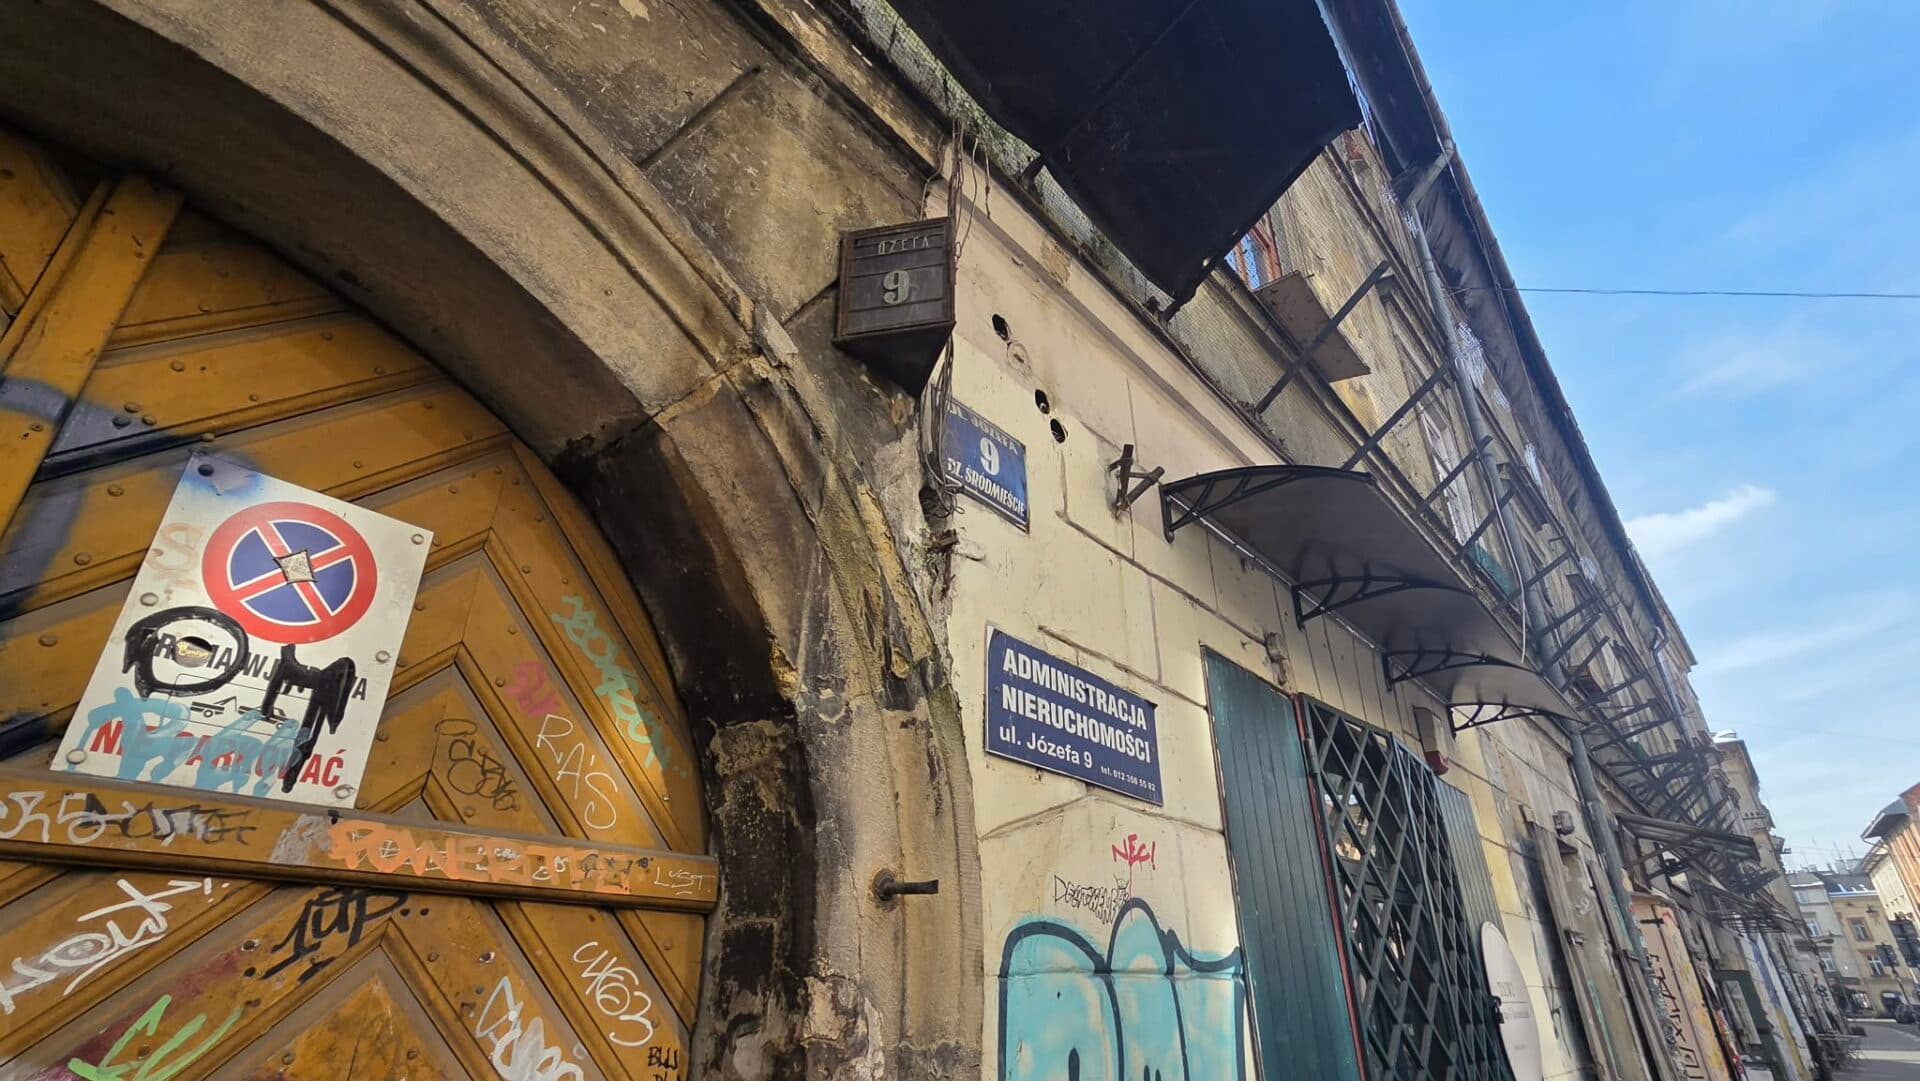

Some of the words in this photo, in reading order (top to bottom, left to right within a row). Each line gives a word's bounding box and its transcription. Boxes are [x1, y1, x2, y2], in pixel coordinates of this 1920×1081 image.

[883, 270, 910, 305] 9
[980, 437, 1000, 476] 9
[965, 464, 1025, 517] ŚRÓDMIEŚCIE
[1003, 647, 1147, 730] ADMINISTRACJA
[1002, 683, 1150, 763] NIERUCHOMOŚCI
[999, 725, 1021, 745] ul.
[1027, 732, 1080, 765] Józefa
[1084, 751, 1093, 769] 9
[1100, 765, 1112, 776] tel.
[1113, 769, 1125, 781] 012
